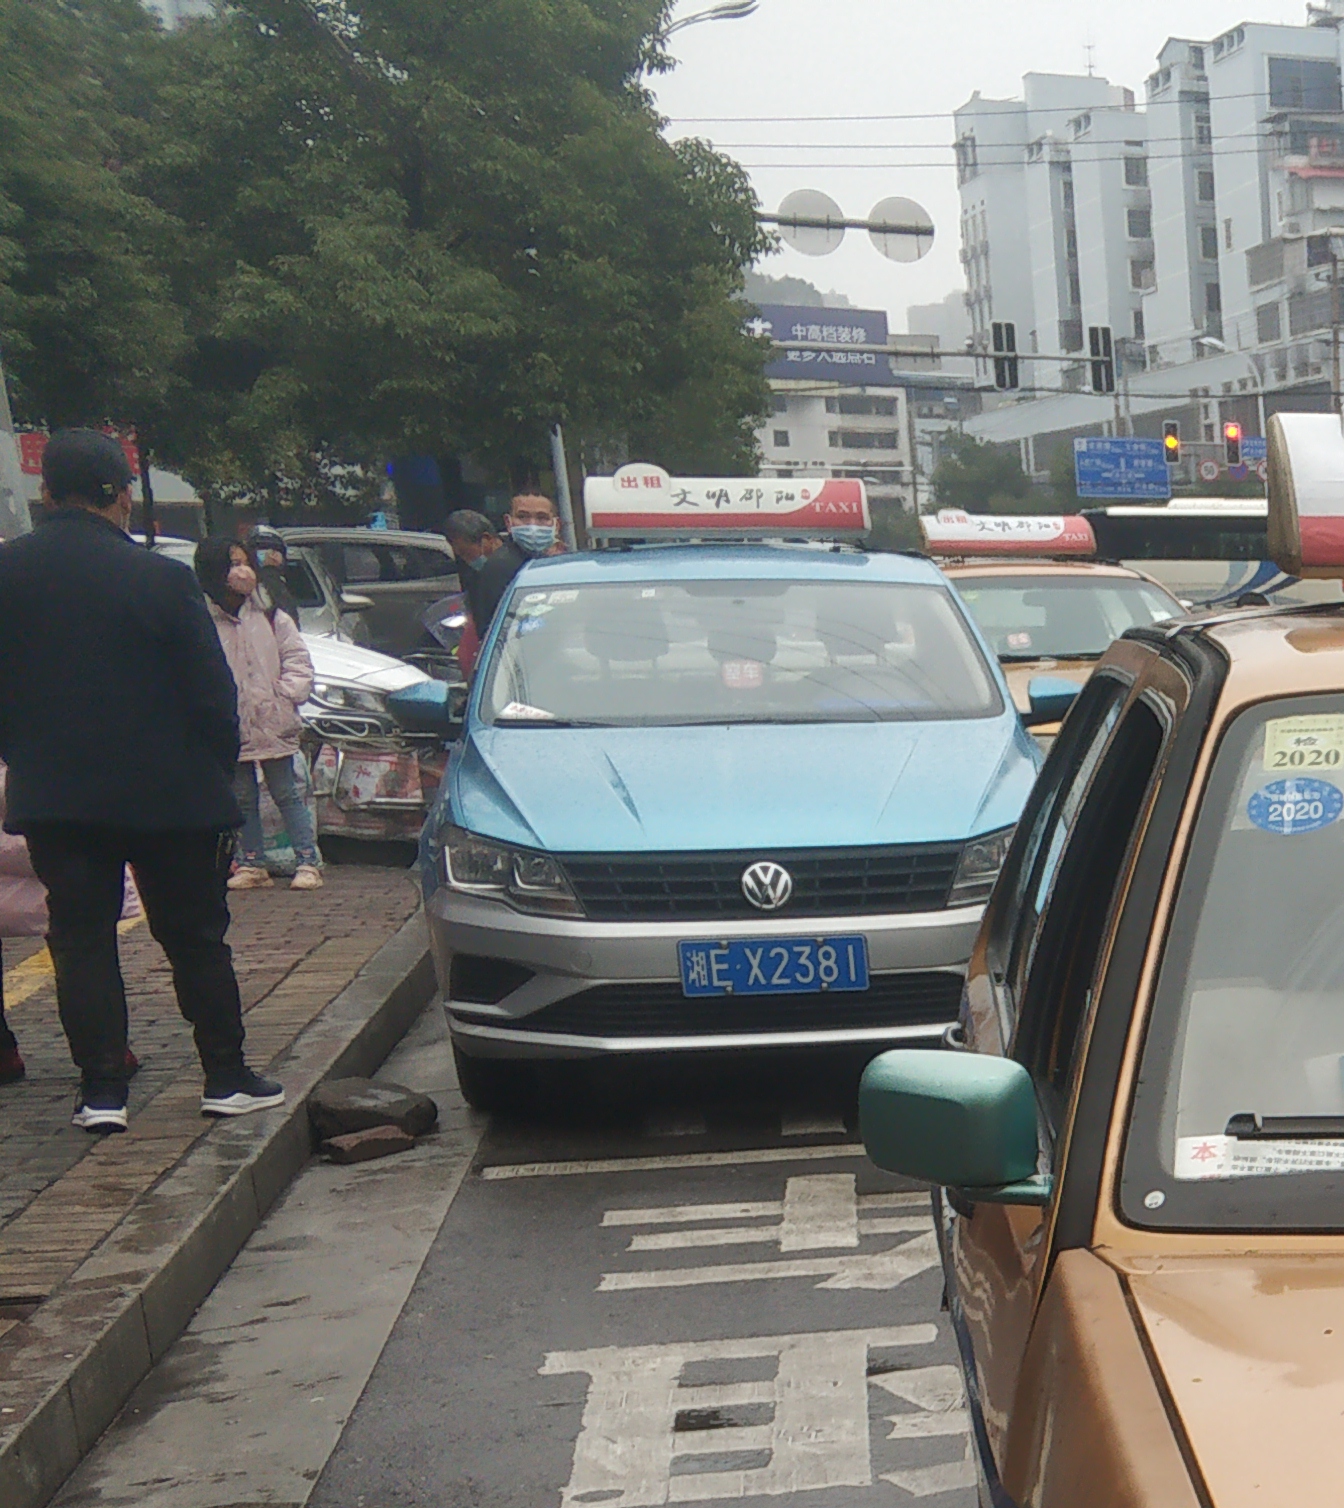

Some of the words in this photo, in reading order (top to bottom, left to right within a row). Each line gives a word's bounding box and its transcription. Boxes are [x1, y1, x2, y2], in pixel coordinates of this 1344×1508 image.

[791, 323, 867, 344] 中高档装修
[1204, 464, 1215, 476] 50
[620, 475, 663, 489] 出租
[670, 488, 796, 509] 文明邵阳
[811, 501, 859, 514] TAXI
[1272, 749, 1341, 767] 2020
[1267, 801, 1324, 821] 2020
